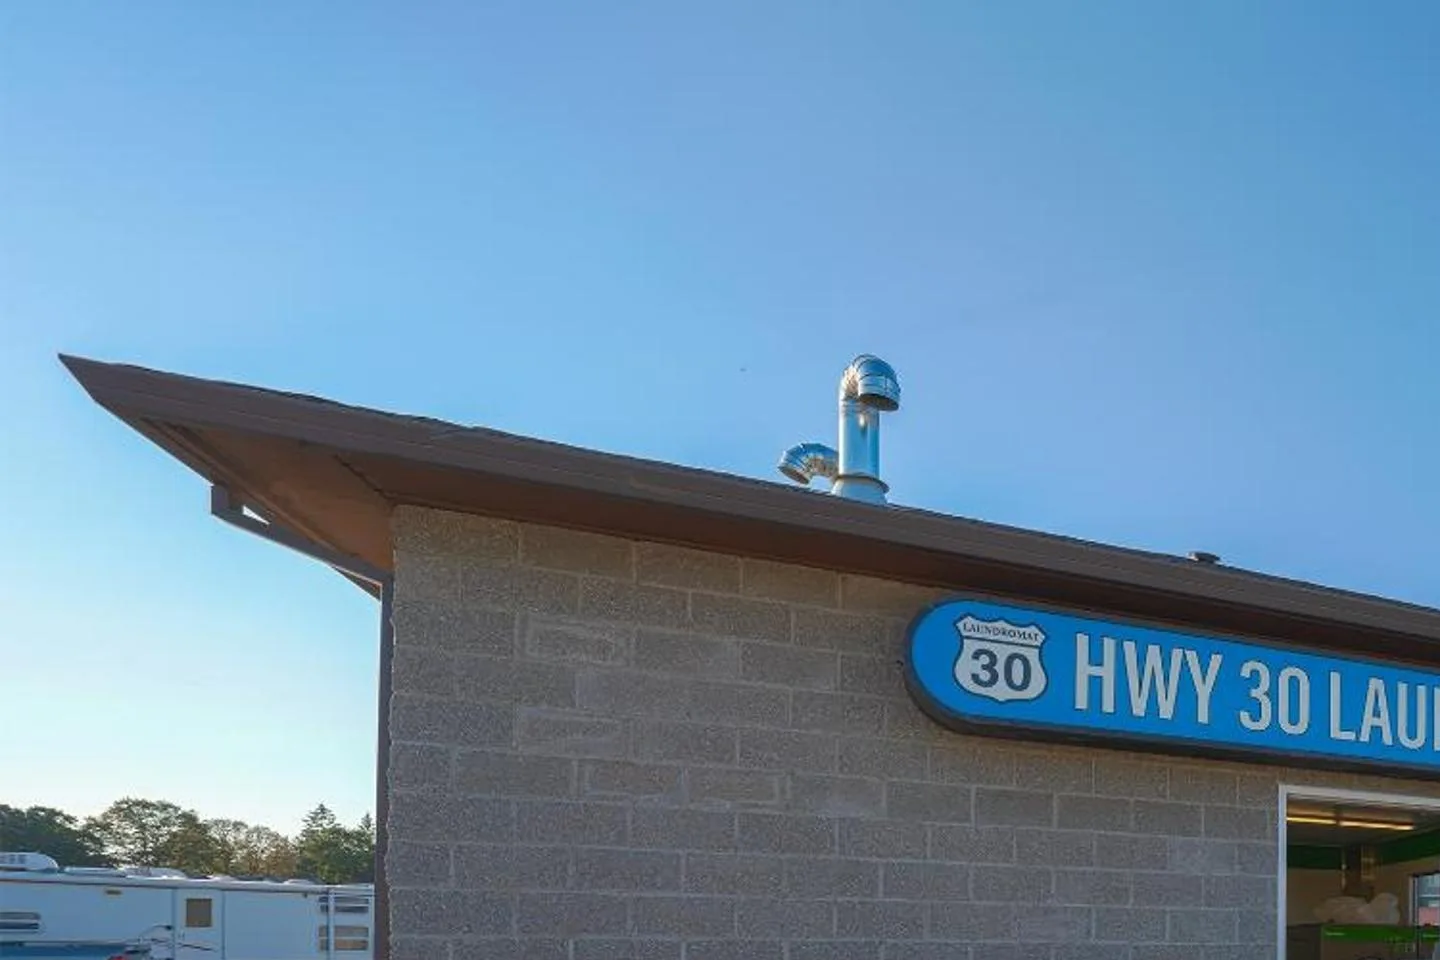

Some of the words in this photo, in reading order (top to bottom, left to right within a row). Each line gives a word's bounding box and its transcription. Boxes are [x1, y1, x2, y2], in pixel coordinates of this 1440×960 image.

[963, 622, 1040, 641] LAUNDROMAT
[970, 648, 1032, 692] 30
[1074, 633, 1224, 725] HWY
[1239, 660, 1310, 735] 30
